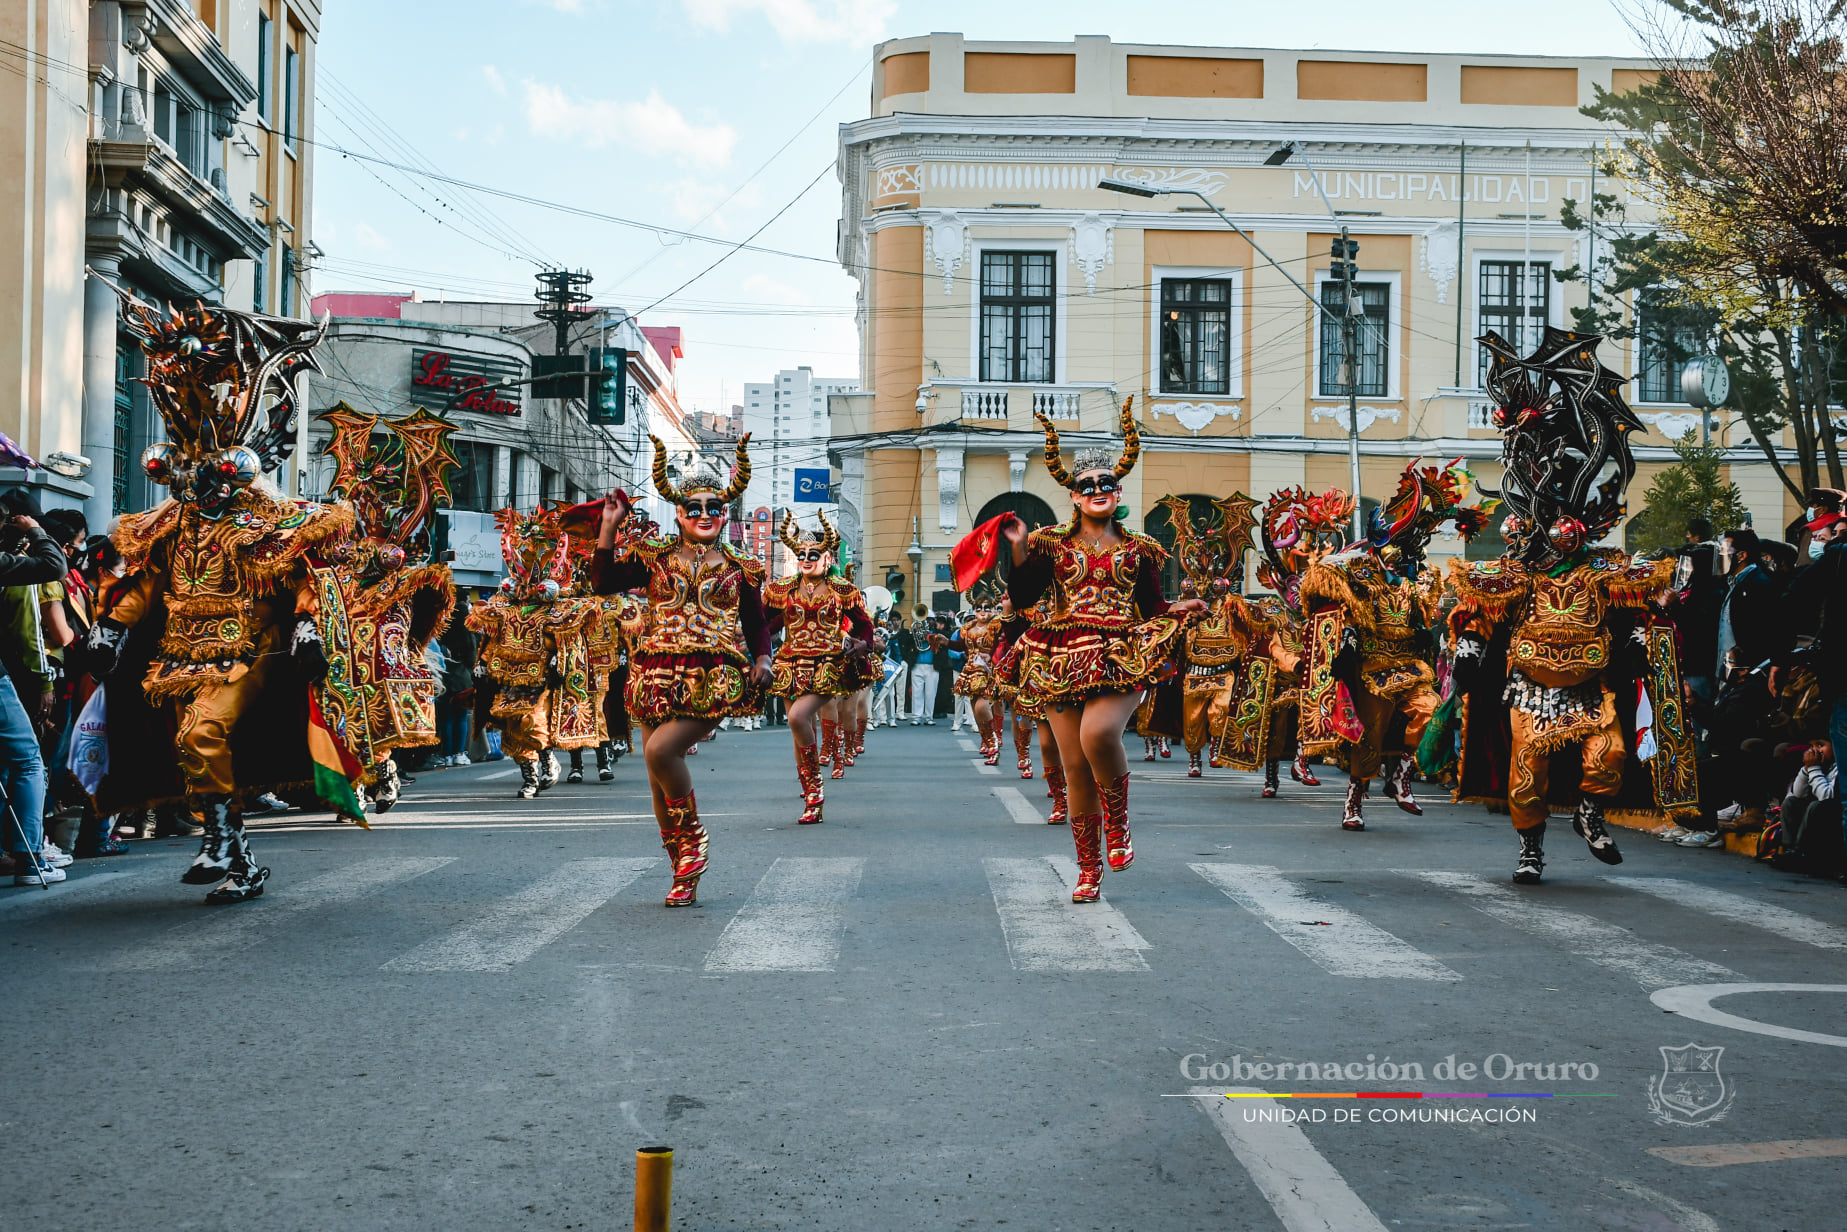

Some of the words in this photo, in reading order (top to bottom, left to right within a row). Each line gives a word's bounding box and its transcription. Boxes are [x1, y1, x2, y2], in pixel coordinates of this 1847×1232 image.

[1293, 171, 1550, 203] MUNICIPALIDAD
[414, 352, 456, 388] La
[455, 375, 521, 414] Polar
